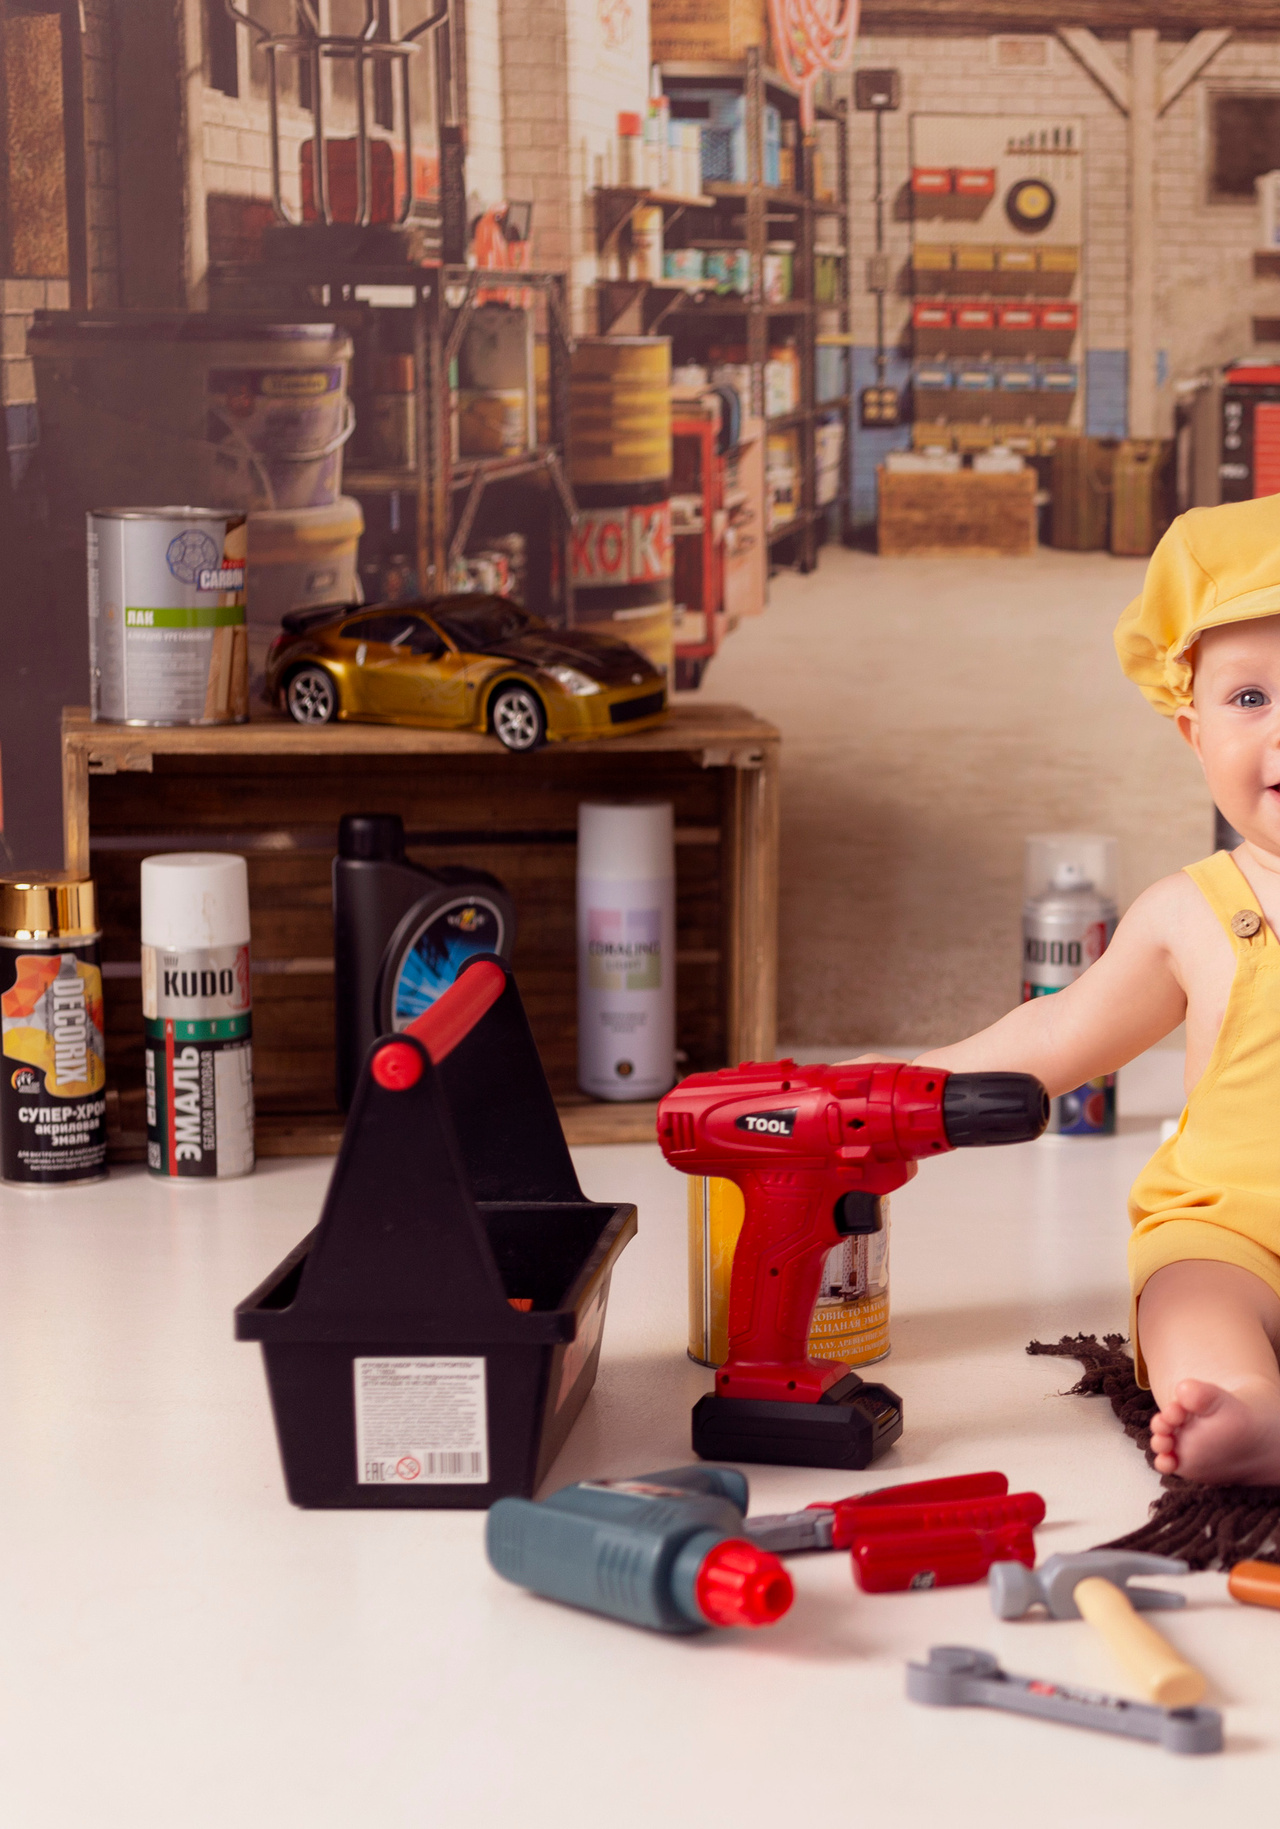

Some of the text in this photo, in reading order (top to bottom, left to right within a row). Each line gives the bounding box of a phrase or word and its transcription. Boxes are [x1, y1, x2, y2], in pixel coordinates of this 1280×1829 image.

[127, 610, 155, 627] ЛАК
[1025, 937, 1082, 966] KUDO
[164, 968, 233, 998] KUDO
[53, 978, 88, 1086] DECORIX
[173, 1046, 202, 1162] ЭМАЛЬ
[34, 1118, 100, 1137] акриловая
[745, 1116, 790, 1135] TOOL
[51, 1132, 90, 1147] эмаль
